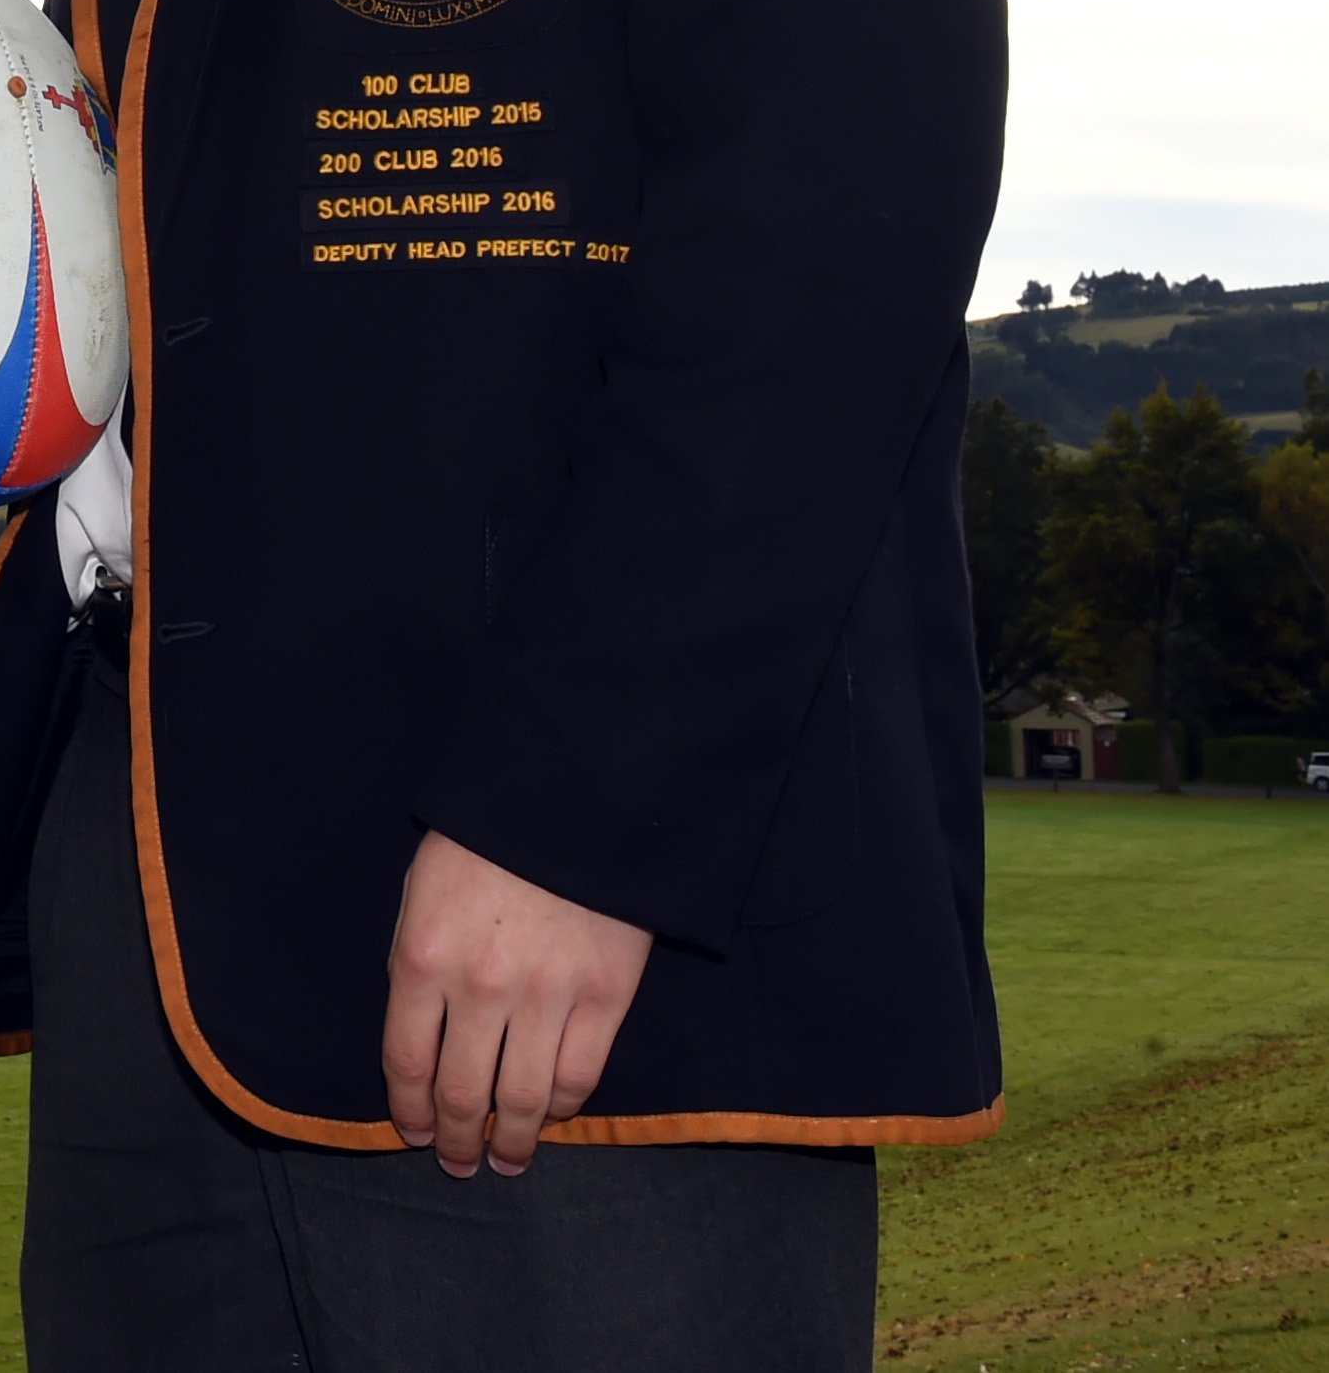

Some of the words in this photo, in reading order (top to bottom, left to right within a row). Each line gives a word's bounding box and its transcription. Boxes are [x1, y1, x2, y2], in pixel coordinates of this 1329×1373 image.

[428, 1, 467, 24] LUX
[362, 75, 398, 96] 100
[408, 73, 471, 95] CLUB
[315, 106, 481, 130] SCHOLARSHIP
[491, 101, 542, 125] 2015
[319, 153, 362, 174] 200
[373, 149, 439, 172] CLUB
[449, 146, 503, 168] 2016
[317, 193, 490, 219] SCHOLARSHIP
[502, 190, 556, 212] 2016
[313, 242, 397, 263] DEPUTY
[408, 241, 466, 260] HEAD
[476, 239, 576, 259] PREFECT
[585, 242, 631, 264] 2017
